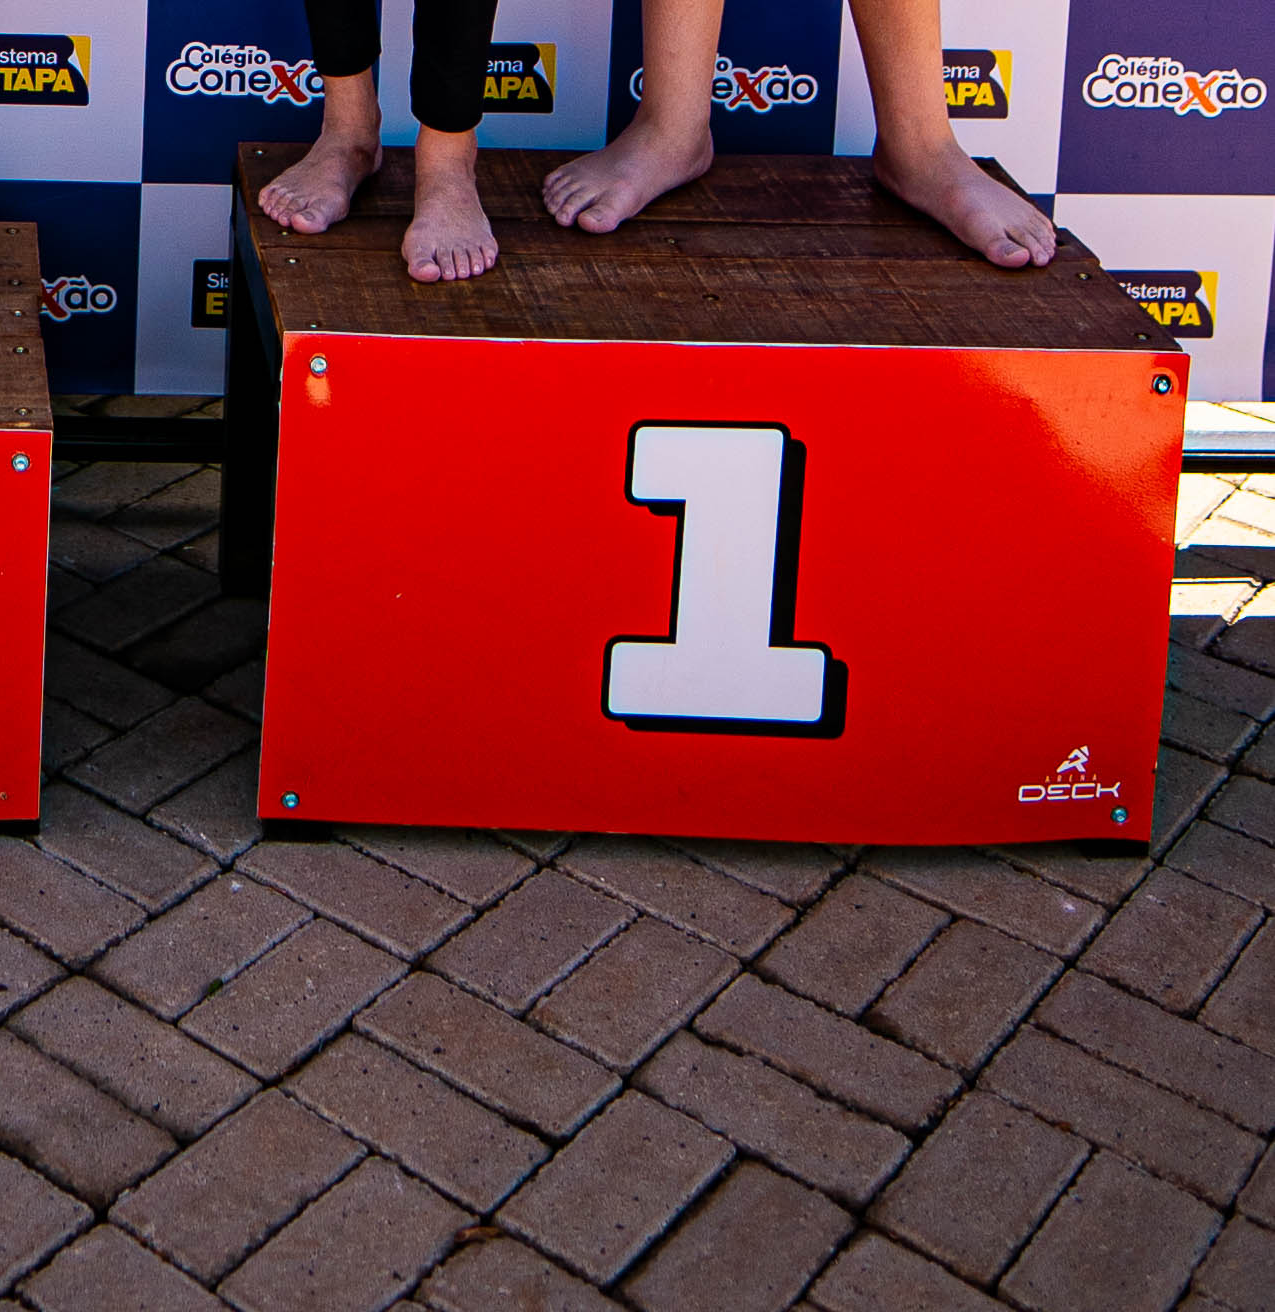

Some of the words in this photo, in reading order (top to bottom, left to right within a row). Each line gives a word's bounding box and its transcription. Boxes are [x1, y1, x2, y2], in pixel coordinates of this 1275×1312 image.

[185, 43, 266, 69] Colégio
[1103, 56, 1180, 80] Colégio
[170, 60, 326, 103] ConeX
[484, 76, 540, 100] APA
[942, 81, 995, 107] APA
[1139, 301, 1201, 326] APA
[603, 421, 836, 731] 1
[1018, 782, 1121, 802] DECK
